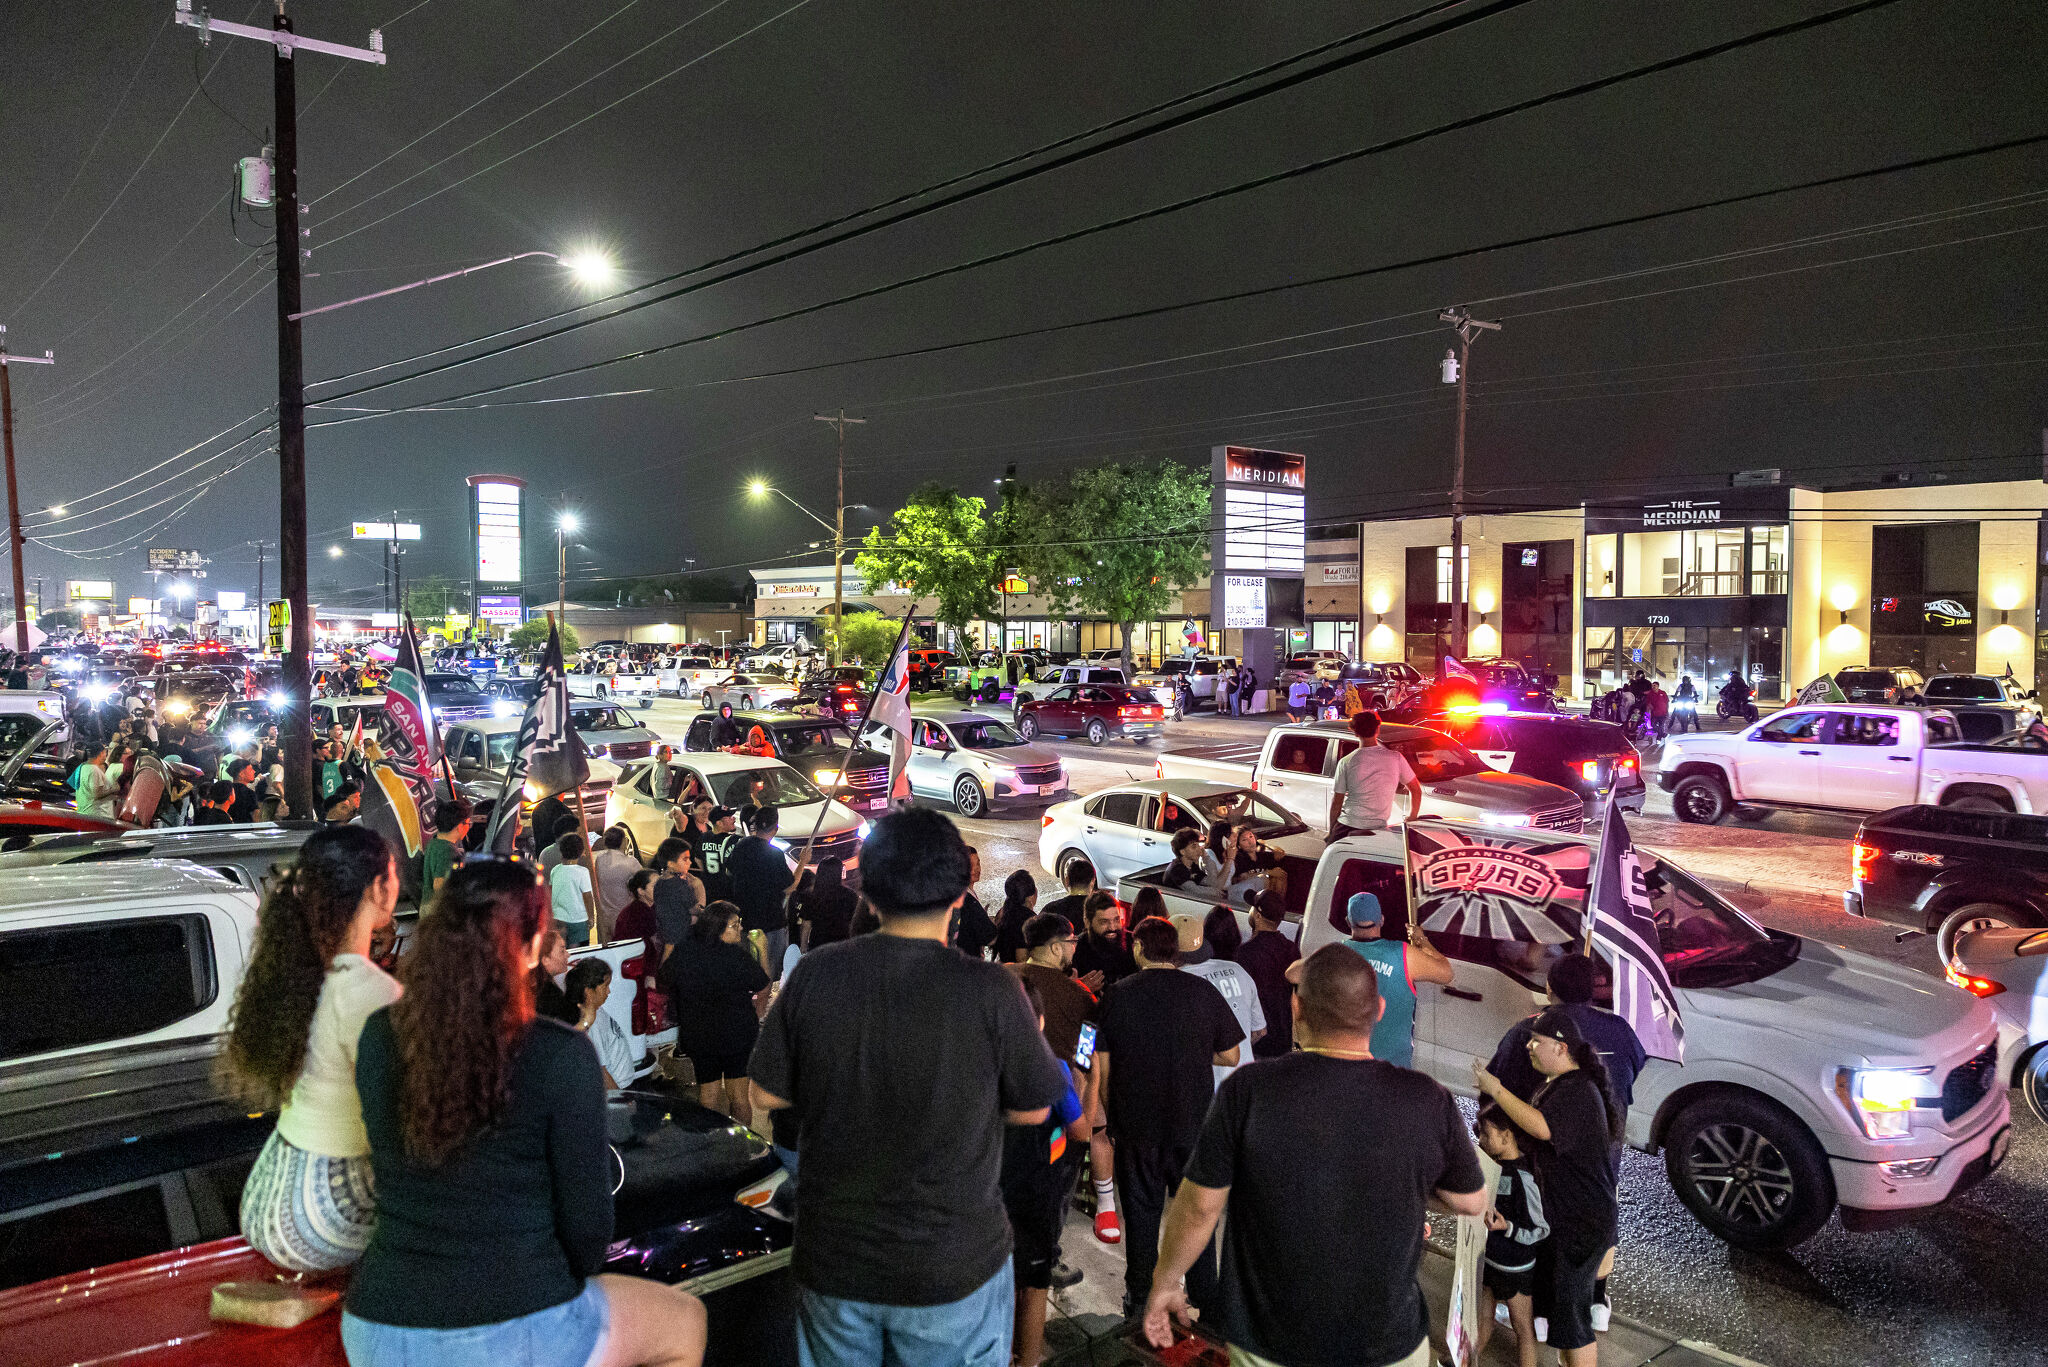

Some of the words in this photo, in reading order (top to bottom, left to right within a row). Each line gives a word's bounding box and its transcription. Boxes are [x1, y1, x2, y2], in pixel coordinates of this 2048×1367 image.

[1232, 466, 1300, 485] MERIDIAN
[1671, 500, 1693, 509] THE
[1643, 510, 1721, 527] MERIDIAN
[1227, 578, 1241, 586] FOR
[1242, 578, 1264, 587] LEASE
[1647, 615, 1670, 624] 1730
[391, 701, 420, 738] SAN
[326, 778, 334, 794] 3
[1438, 851, 1466, 861] SAN
[1473, 850, 1541, 871] ANTONIO
[1431, 862, 1542, 896] SPURS
[1203, 968, 1236, 981] TIFIED
